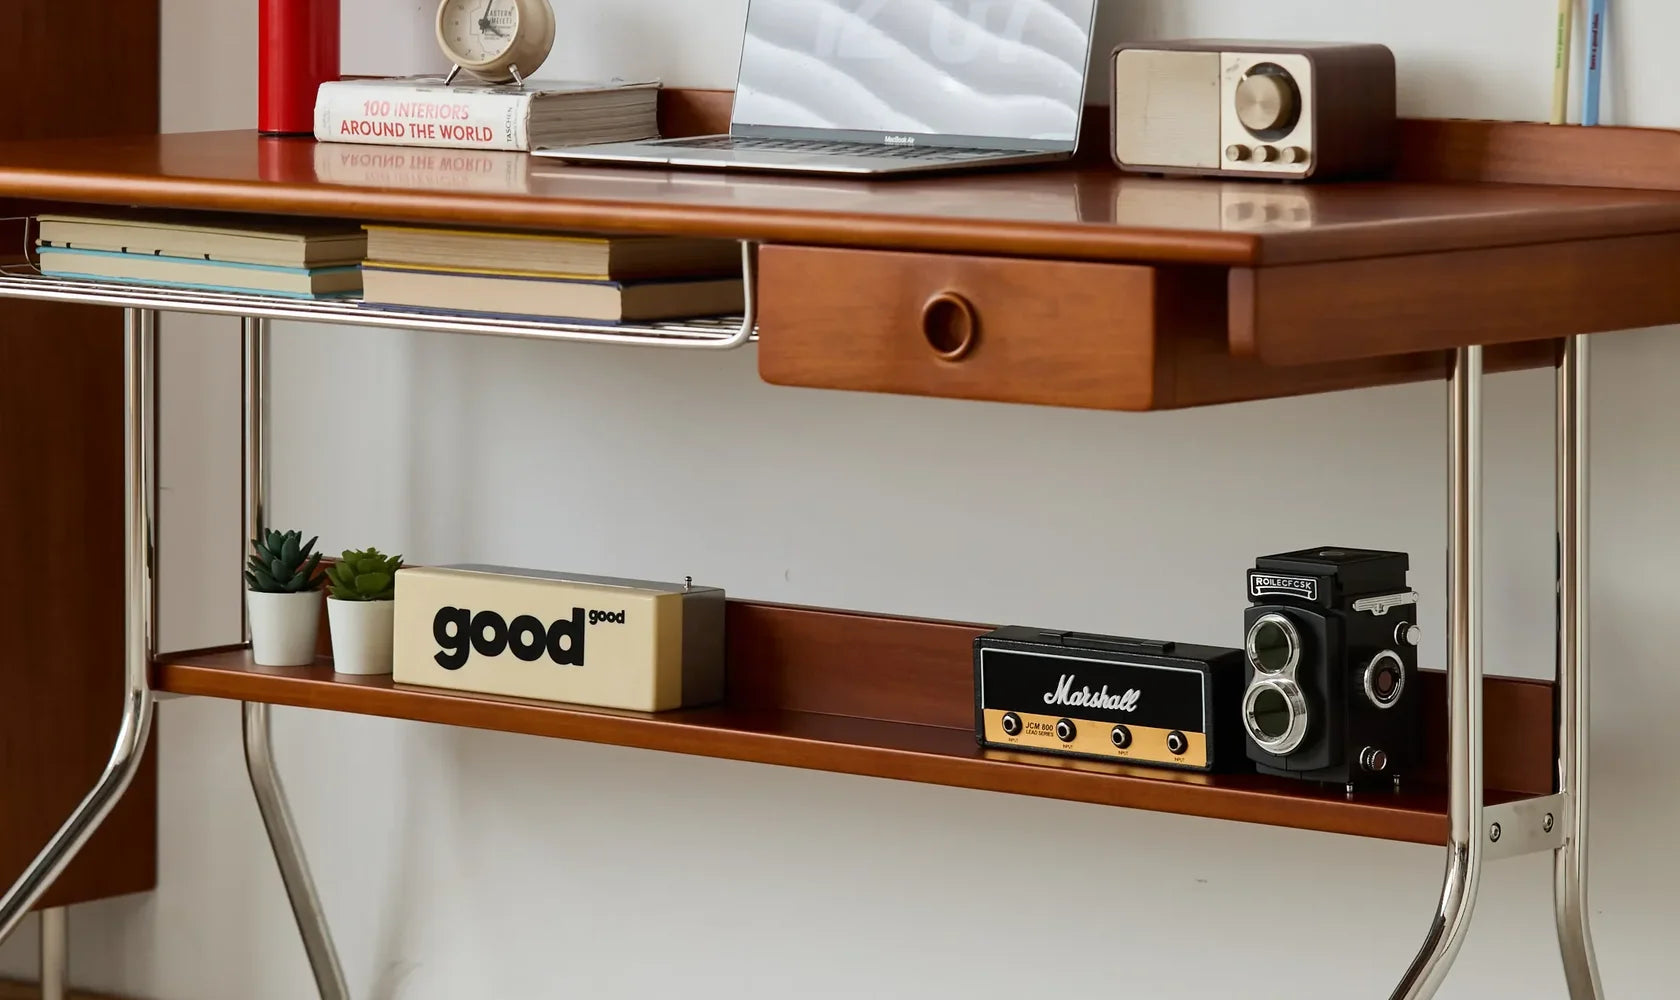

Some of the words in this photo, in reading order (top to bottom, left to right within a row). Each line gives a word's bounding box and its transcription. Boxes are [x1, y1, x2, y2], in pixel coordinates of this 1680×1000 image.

[363, 100, 390, 117] 100
[394, 101, 470, 120] INTERIORS
[340, 120, 405, 138] AROUND
[409, 123, 435, 139] THE
[439, 124, 493, 142] WORLD
[433, 606, 586, 670] good
[588, 609, 625, 626] good
[1043, 674, 1141, 712] Marshall
